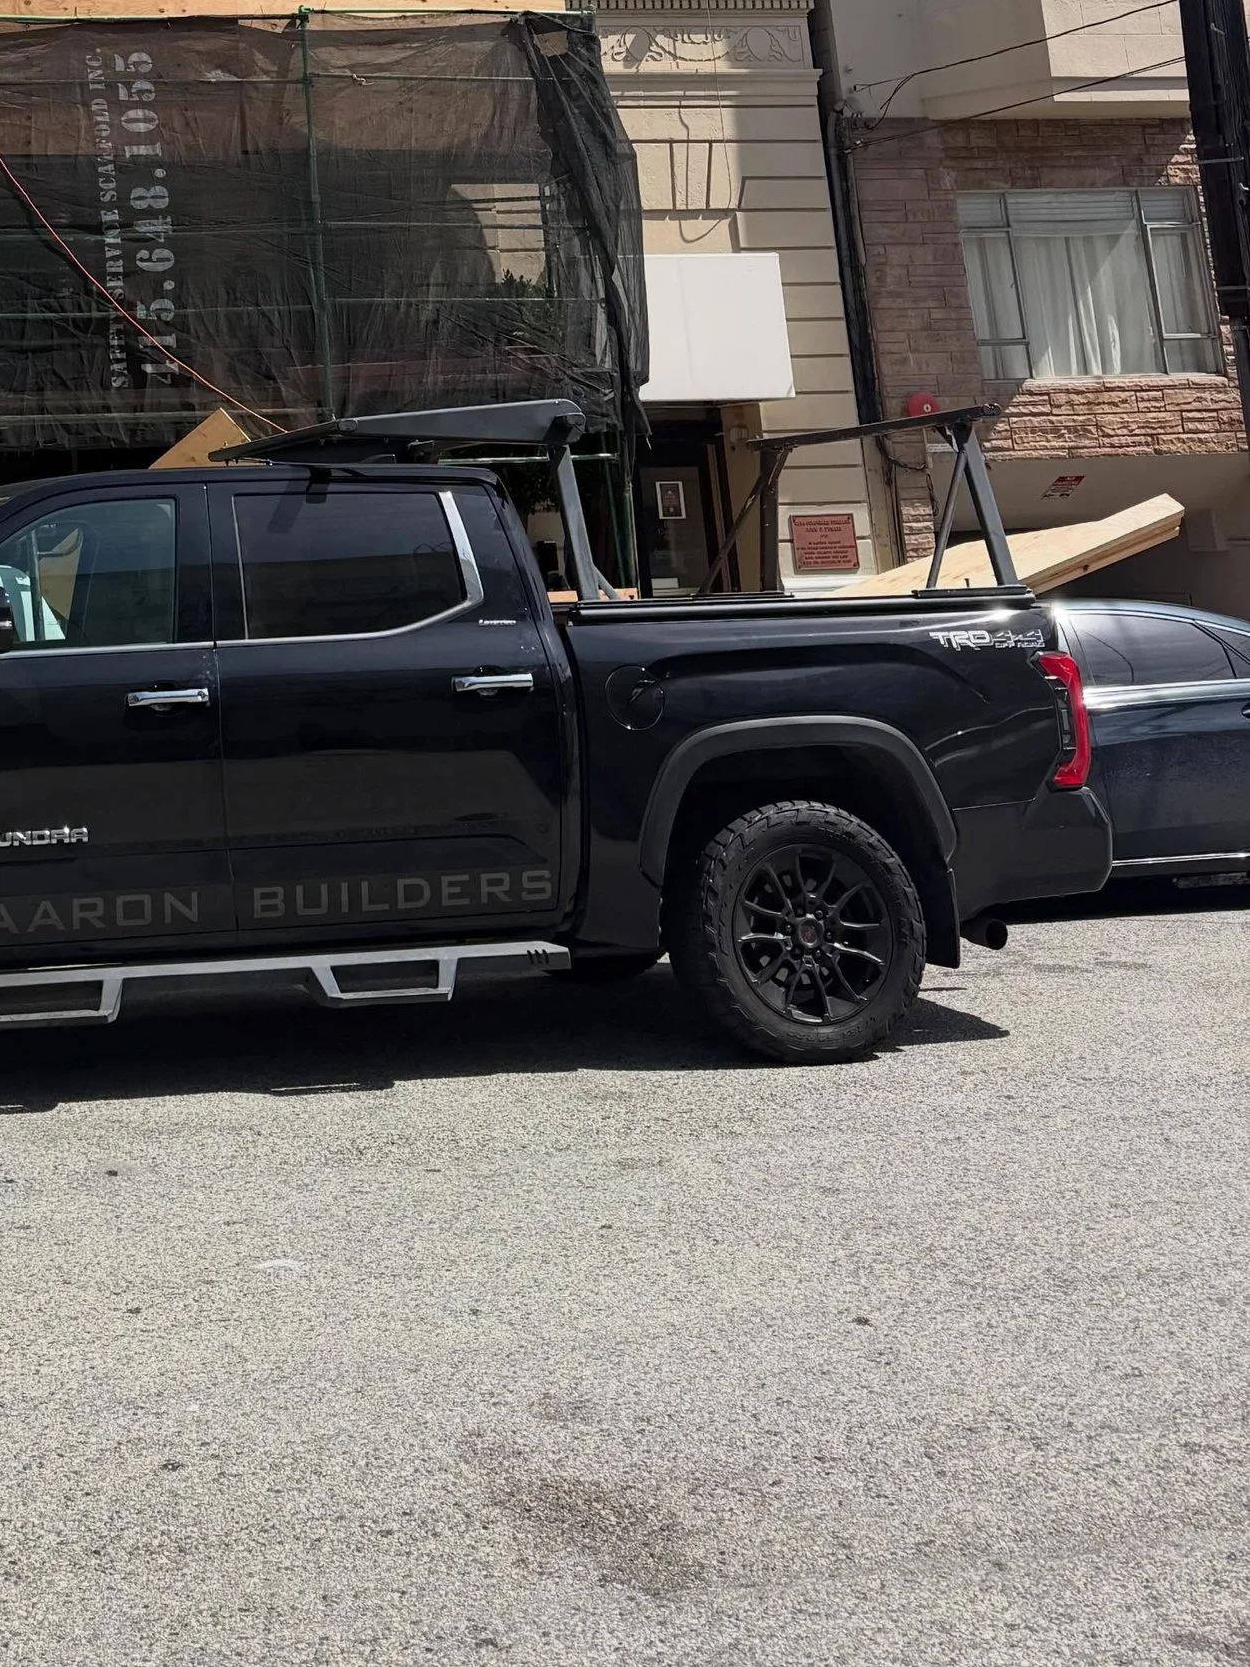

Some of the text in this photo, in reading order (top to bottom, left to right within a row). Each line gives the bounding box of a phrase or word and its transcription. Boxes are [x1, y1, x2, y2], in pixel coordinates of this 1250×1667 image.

[86, 48, 104, 90] INC.
[114, 52, 180, 384] 415.648.1055
[101, 209, 125, 300] SERVICE
[929, 630, 993, 651] TRD
[253, 870, 553, 919] BUILDERS
